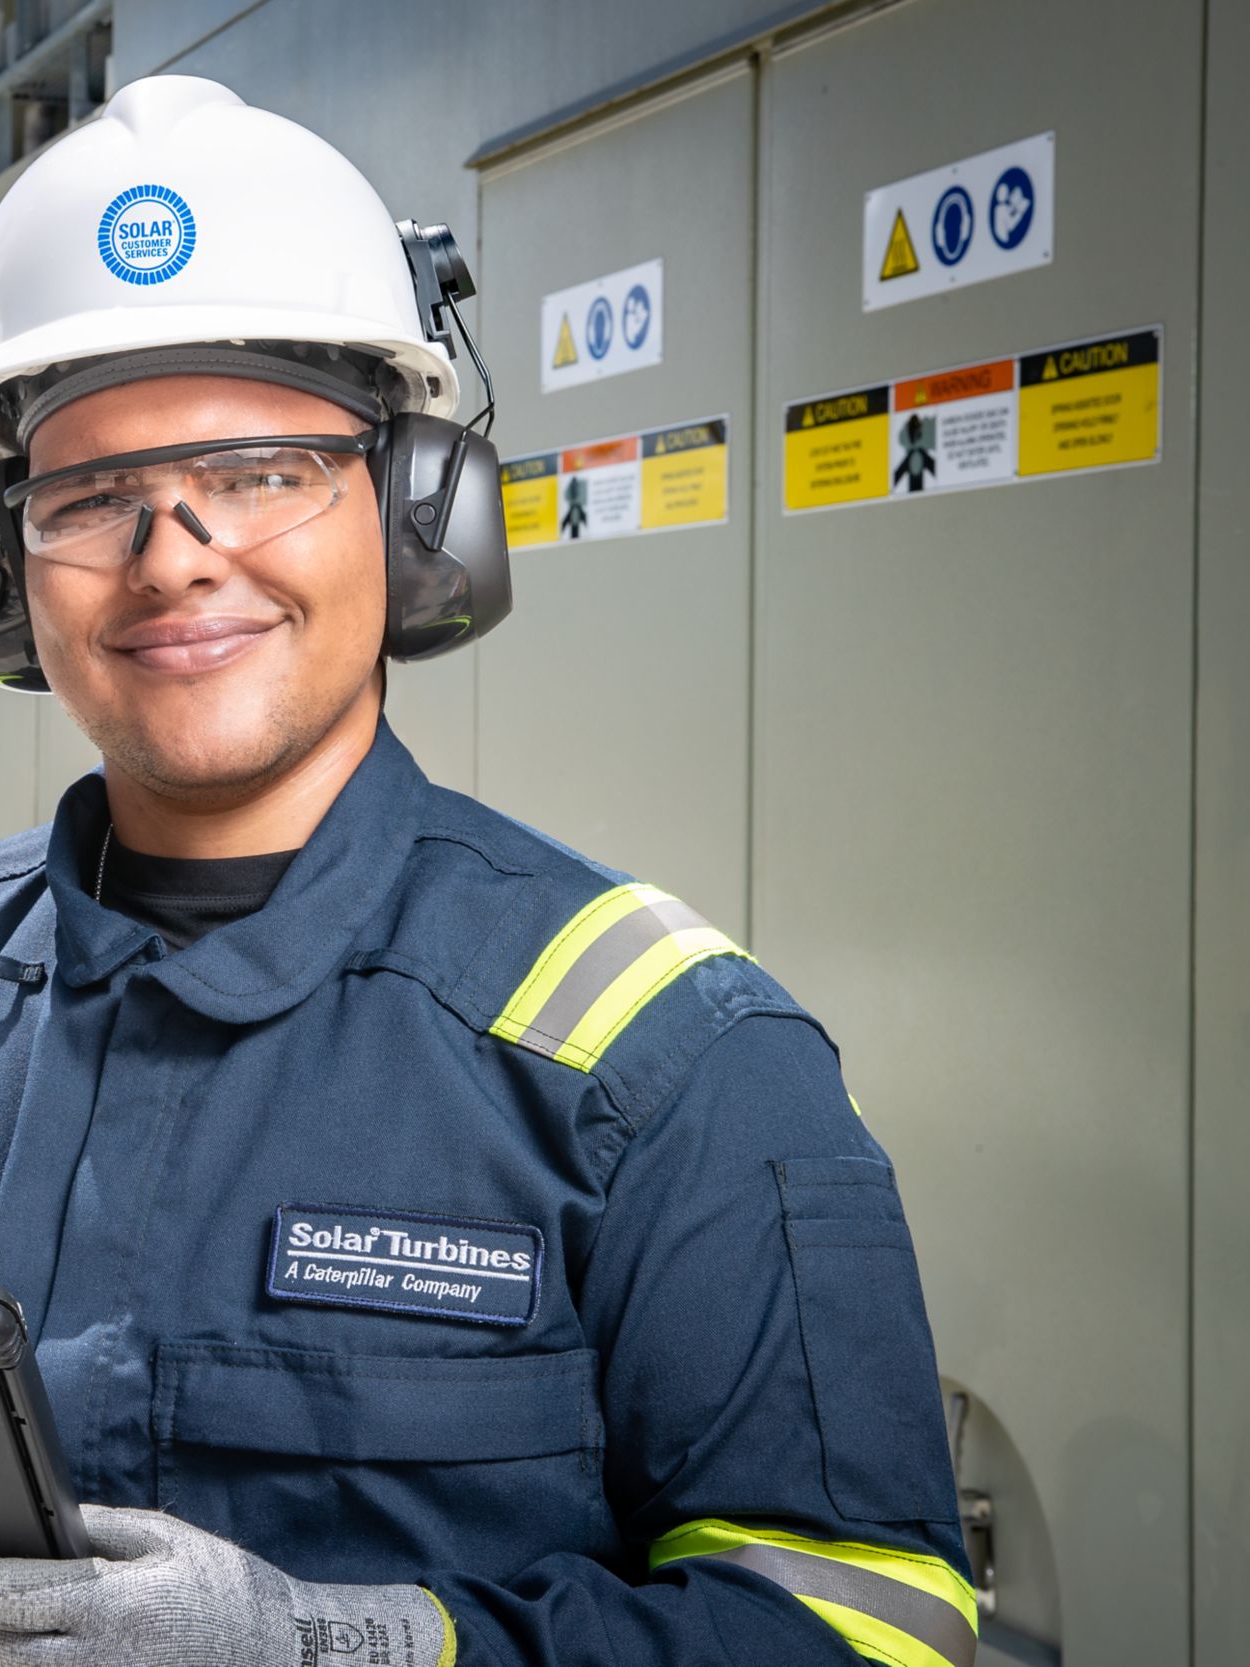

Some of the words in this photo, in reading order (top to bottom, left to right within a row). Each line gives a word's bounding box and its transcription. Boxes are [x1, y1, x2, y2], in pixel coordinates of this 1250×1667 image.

[119, 220, 172, 239] SOLAR
[121, 238, 171, 250] CUSTOMER
[125, 248, 168, 259] SERVICES
[1060, 342, 1128, 374] CAUTION
[930, 370, 991, 398] WARNING
[814, 394, 869, 423] CAUTION
[380, 1230, 531, 1270] Turbines
[284, 1261, 298, 1279] A
[303, 1264, 395, 1289] Caterpillar
[401, 1274, 482, 1302] Company
